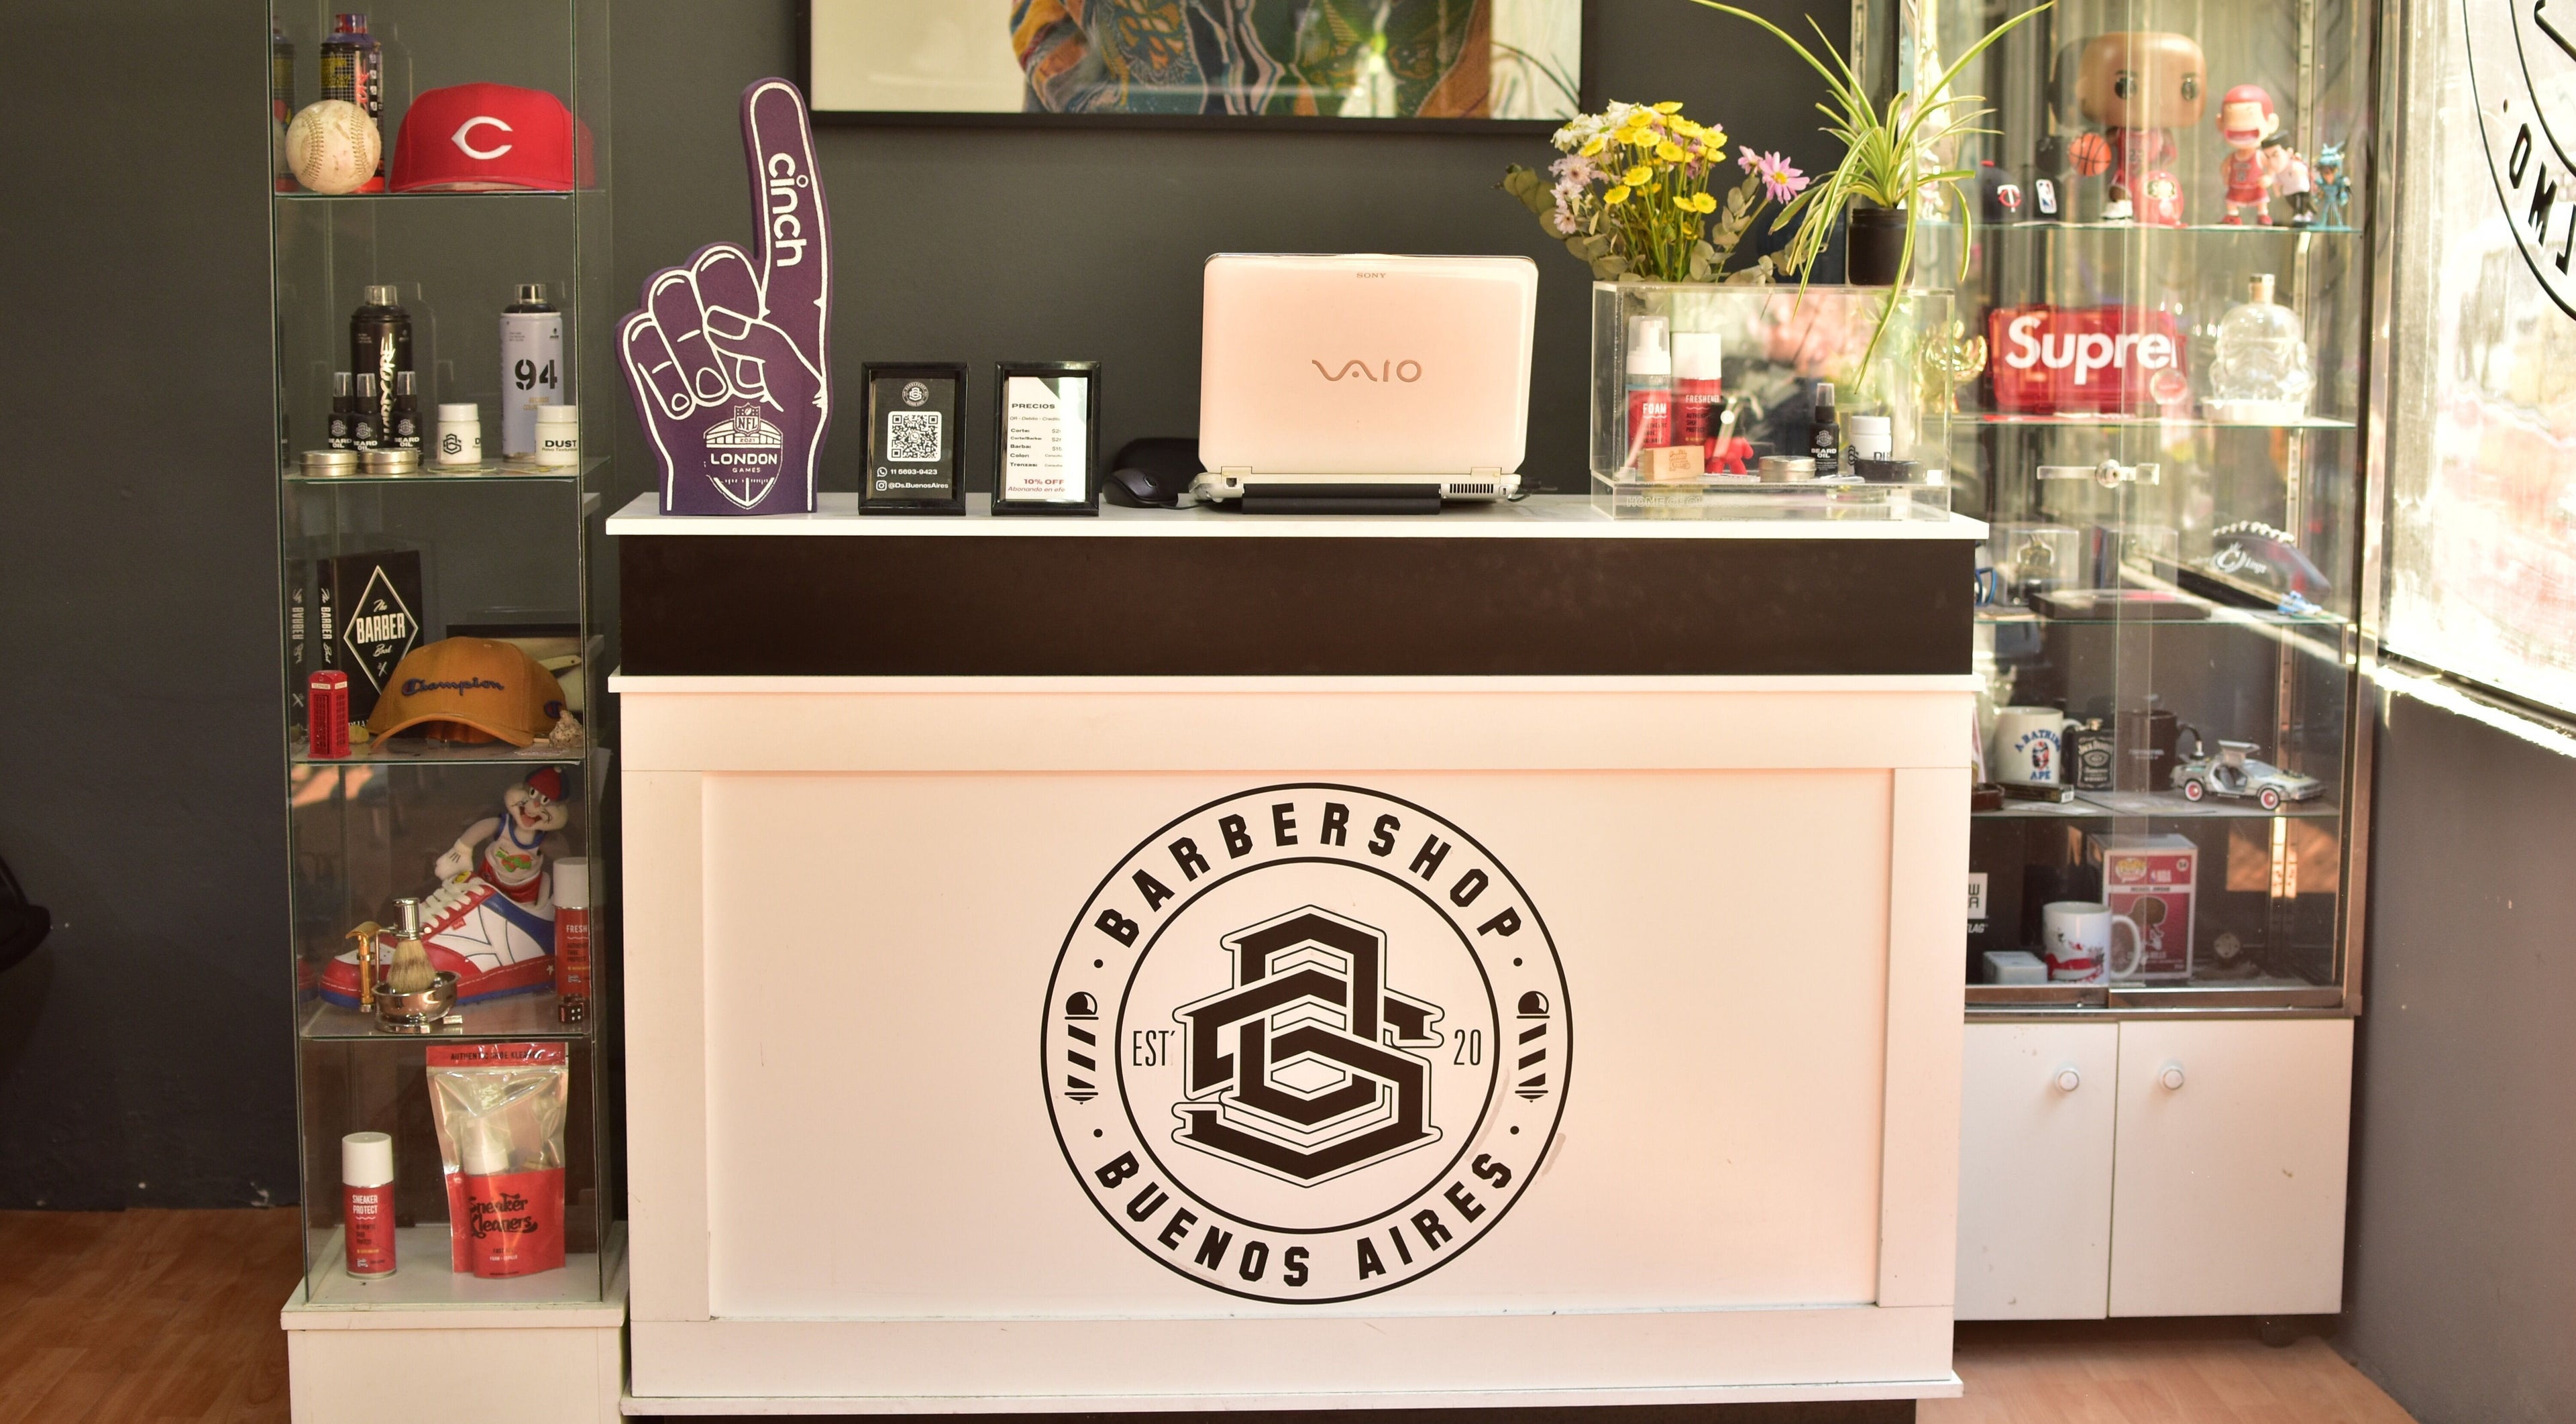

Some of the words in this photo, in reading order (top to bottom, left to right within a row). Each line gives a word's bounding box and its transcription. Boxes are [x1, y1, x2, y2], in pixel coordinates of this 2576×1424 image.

[767, 152, 809, 268] cinch
[514, 358, 558, 391] 94
[1311, 359, 1423, 383] VAIO
[1642, 402, 1667, 415] FOAM
[738, 417, 757, 431] NFL
[545, 440, 577, 448] DUST
[710, 453, 778, 465] LONDON
[1626, 496, 1665, 508] HOME
[1667, 496, 1686, 508] OF
[373, 598, 388, 613] The
[321, 606, 333, 640] BARBER
[356, 612, 406, 645] BARBER
[401, 676, 505, 697] Champion
[2029, 771, 2051, 781] APE
[1093, 801, 1522, 948] BARBERSHOP
[566, 924, 588, 934] FRESH
[1453, 1028, 1482, 1066] 20
[352, 1195, 378, 1204] SNEAKER
[468, 1192, 529, 1214] Sneaker
[352, 1205, 378, 1215] PROTECT
[1094, 1150, 1309, 1286] BUENOS
[1356, 1152, 1512, 1280] AIRES
